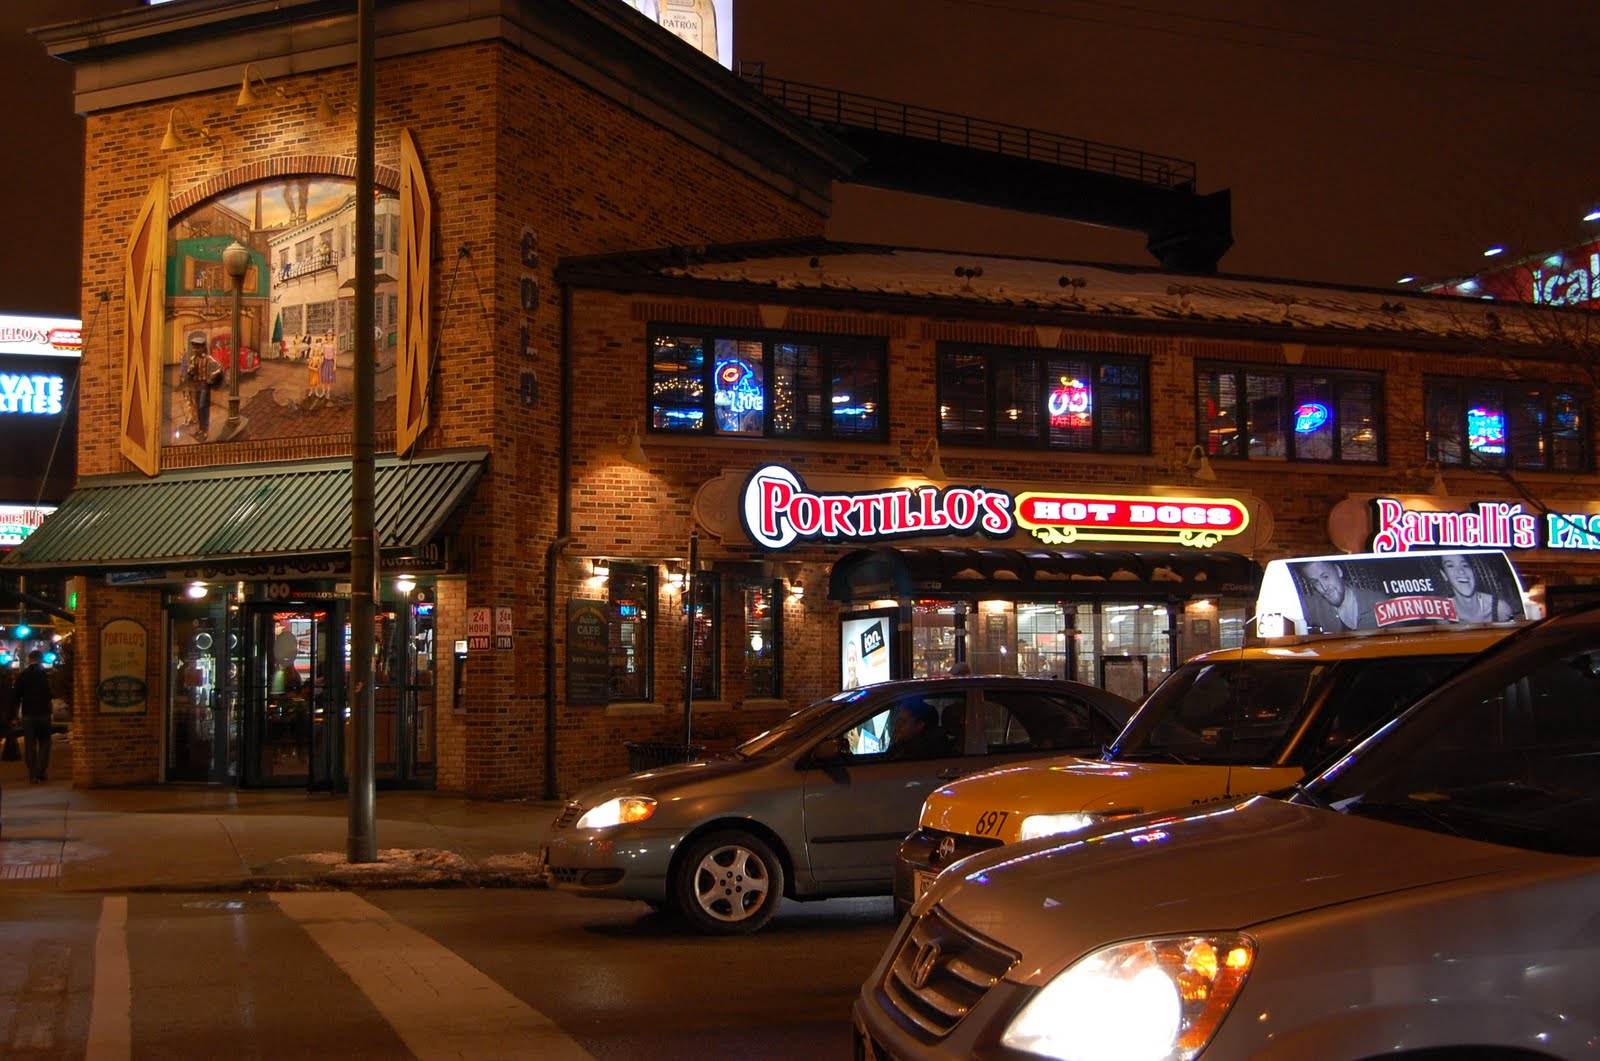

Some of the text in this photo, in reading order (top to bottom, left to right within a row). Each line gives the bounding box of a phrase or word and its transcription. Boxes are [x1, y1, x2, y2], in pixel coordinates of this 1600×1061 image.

[663, 18, 698, 30] PATRÓN
[757, 476, 1015, 537] PORTILLO'S
[1032, 501, 1232, 526] HOT DOGS
[1373, 499, 1536, 553] Barnelli's
[1383, 578, 1435, 594] I CHOOSE
[473, 612, 485, 622] 24
[468, 624, 489, 632] HOUR
[104, 631, 145, 648] PORTILLO'S
[469, 637, 489, 649] ATM
[497, 637, 512, 648] ATM
[975, 810, 1009, 836] 697
